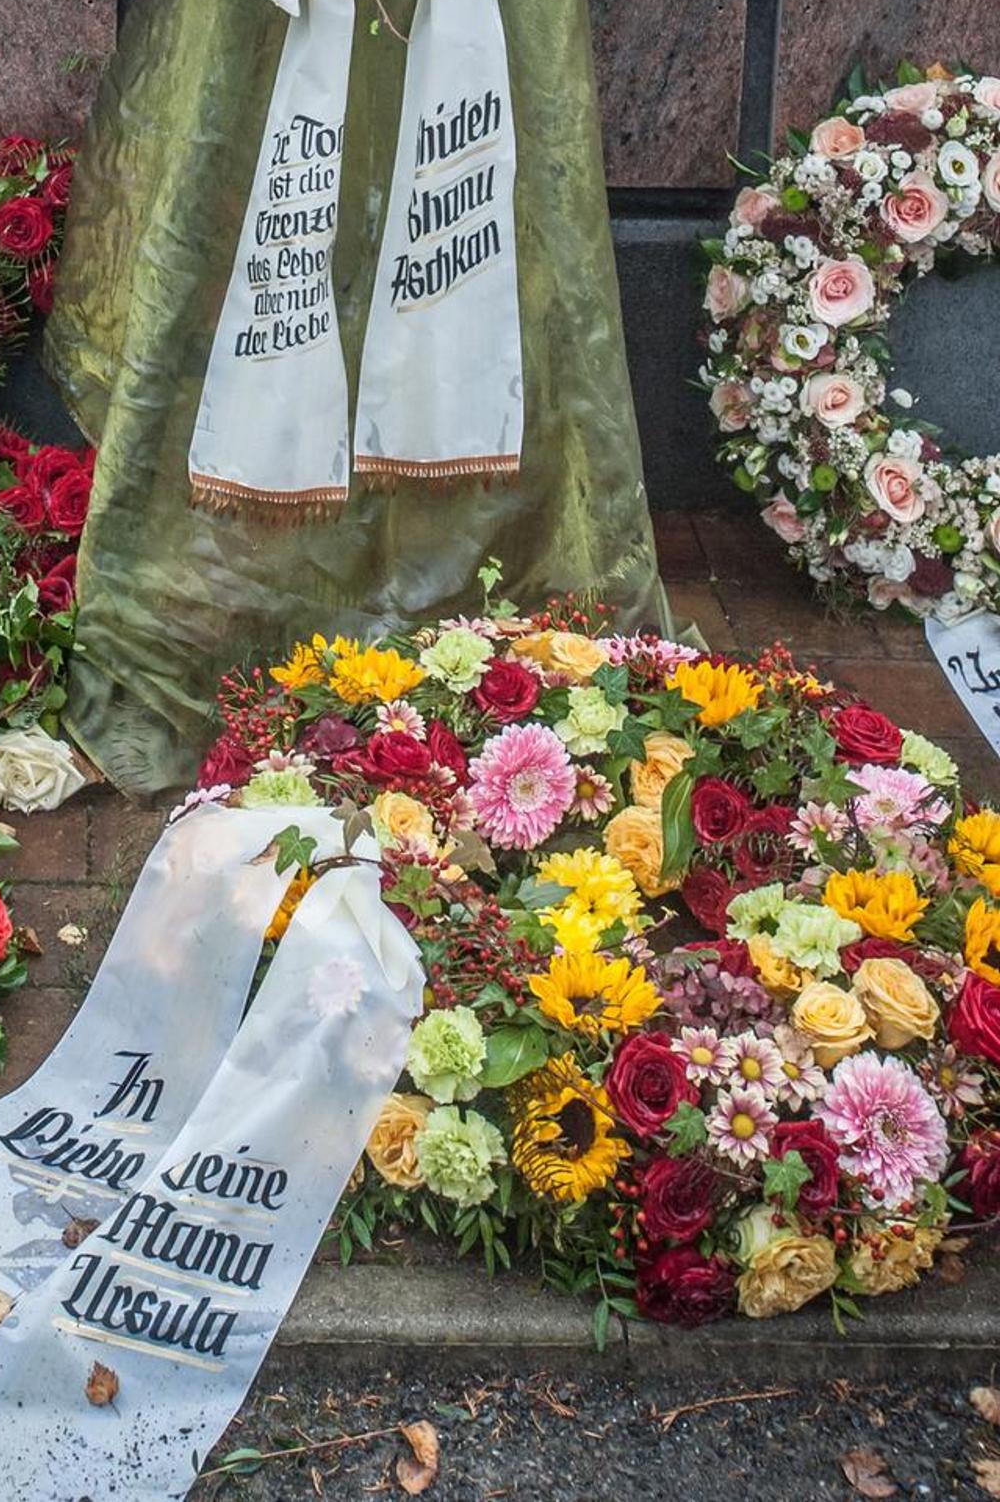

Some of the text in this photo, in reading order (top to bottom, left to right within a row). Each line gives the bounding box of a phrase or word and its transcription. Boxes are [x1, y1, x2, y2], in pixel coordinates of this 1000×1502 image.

[415, 90, 501, 167] hideh
[268, 163, 335, 201] ist die
[255, 202, 337, 246] Grenze
[247, 254, 272, 284] des
[390, 219, 502, 308] Aschkan
[254, 288, 285, 316] aber
[234, 311, 330, 357] der Liebe
[93, 1050, 165, 1123] In
[98, 1191, 275, 1291] Mama
[61, 1253, 239, 1356] Ursula
